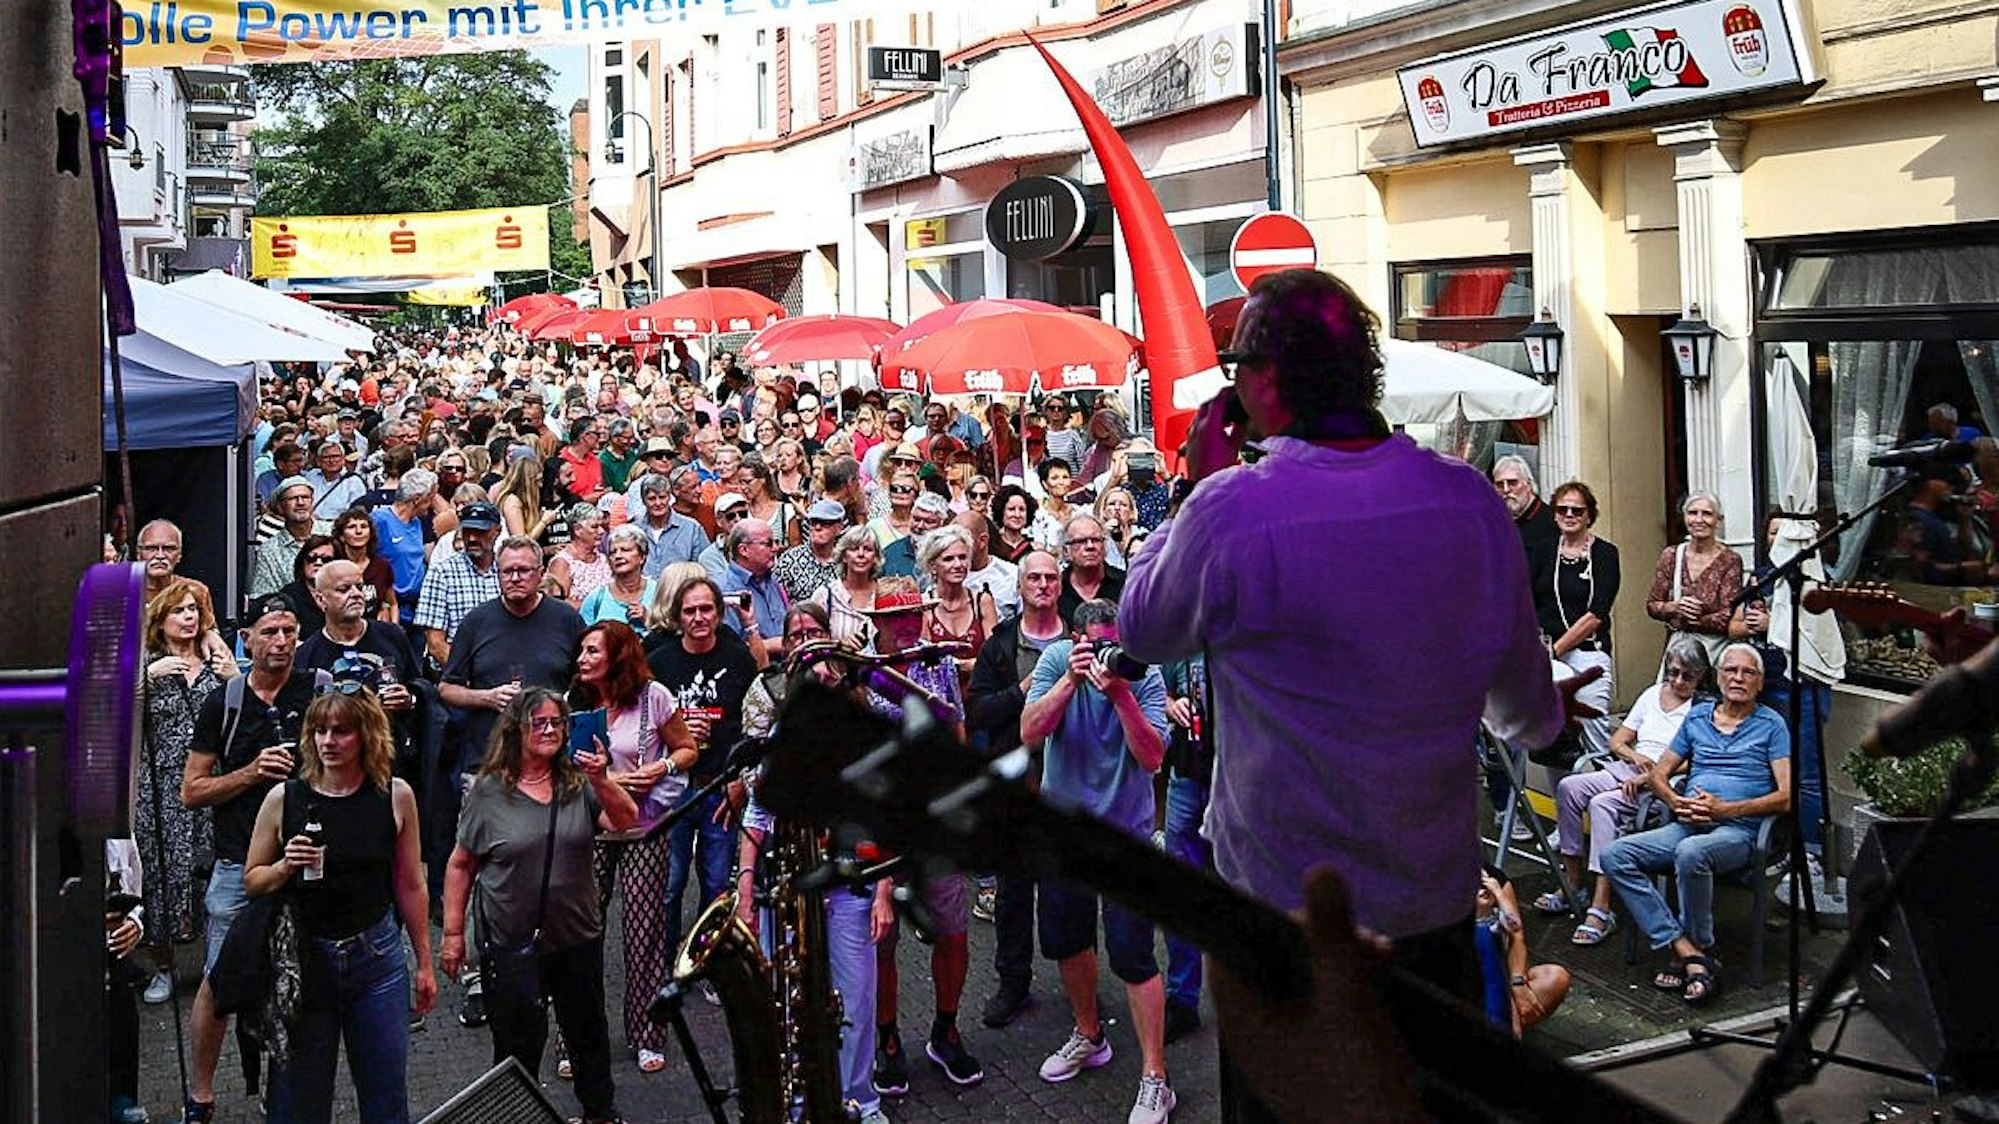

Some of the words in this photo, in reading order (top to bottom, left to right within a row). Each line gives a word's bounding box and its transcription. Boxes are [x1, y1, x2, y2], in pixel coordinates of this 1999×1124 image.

[237, 1, 427, 42] Power
[448, 0, 541, 37] mit
[884, 51, 928, 75] FELLINI
[1463, 62, 1520, 109] Da
[1529, 39, 1686, 95] Franco
[1542, 101, 1555, 115] &
[1555, 94, 1601, 114] Pizzeria
[1006, 194, 1054, 243] FELLINI
